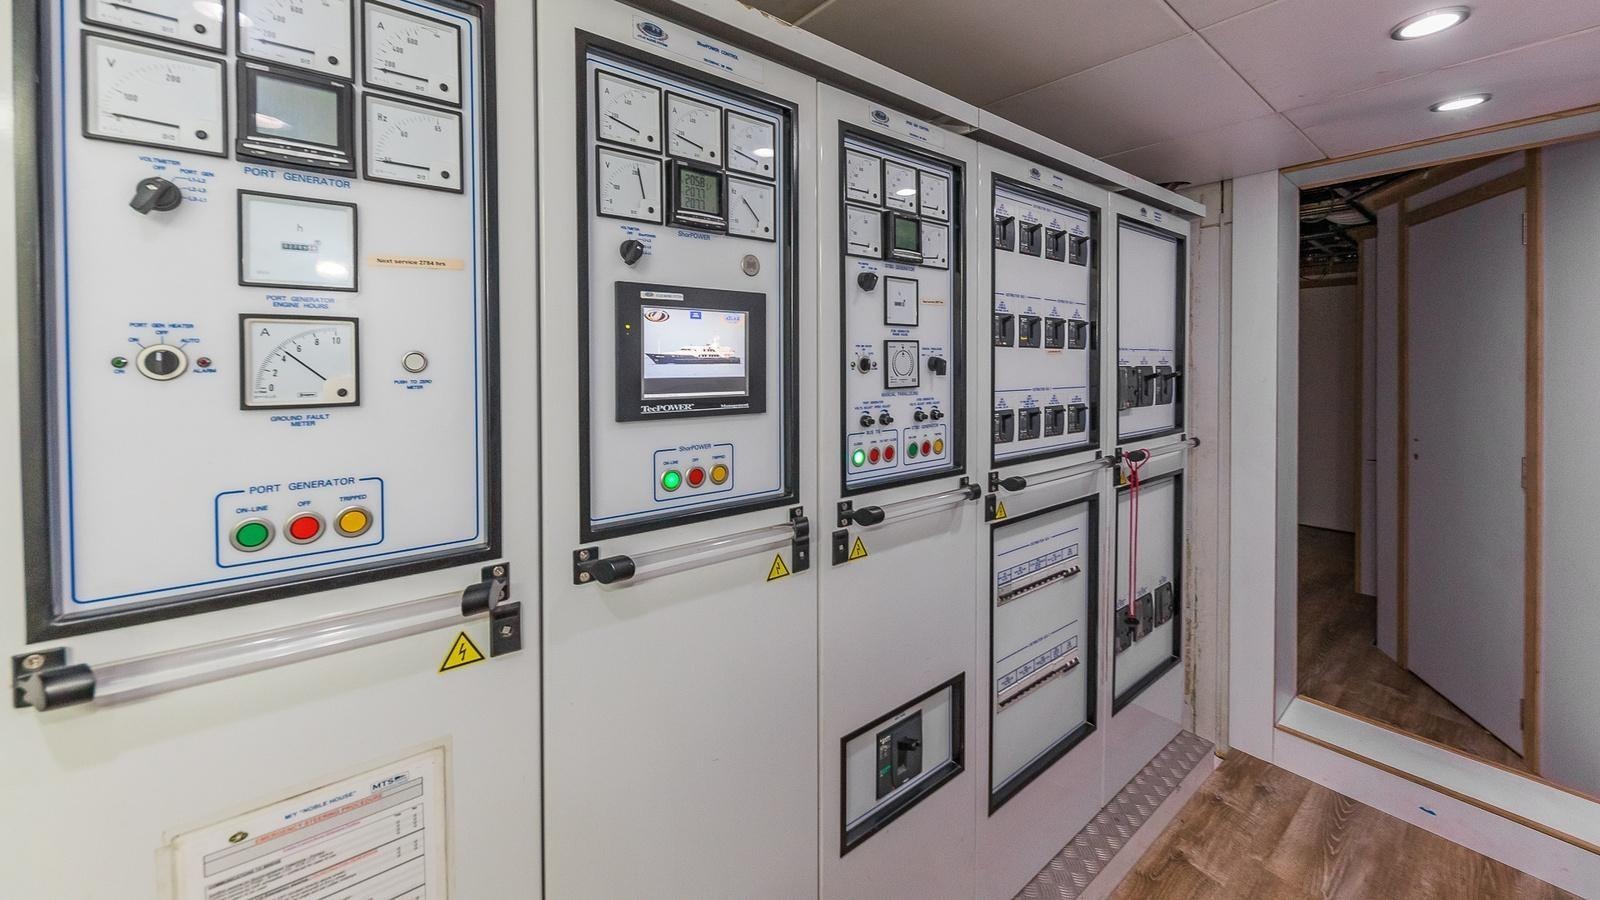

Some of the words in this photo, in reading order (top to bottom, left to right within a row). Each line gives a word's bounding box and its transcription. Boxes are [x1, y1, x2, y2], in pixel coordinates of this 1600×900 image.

[377, 21, 385, 31] A
[106, 57, 117, 67] V
[384, 59, 396, 68] 200
[166, 74, 181, 83] 200
[604, 87, 611, 95] A
[377, 113, 388, 122] Hz
[243, 166, 276, 179] PORT
[283, 171, 352, 189] GENERATOR
[678, 231, 711, 240] ShorPOWER
[394, 258, 418, 266] service
[291, 296, 336, 304] GENERATOR
[260, 328, 270, 337] A
[314, 338, 320, 346] 8
[332, 337, 341, 345] 10
[296, 345, 302, 353] 6
[281, 354, 287, 362] 4
[273, 369, 279, 377] 2
[269, 384, 274, 392] 0
[641, 404, 693, 414] TecPOWER
[270, 415, 302, 423] GROUND
[306, 413, 331, 421] FAULT
[679, 443, 712, 452] ShorPOWER
[249, 484, 281, 494] PORT
[288, 476, 356, 491] GENERATOR
[339, 494, 367, 502] TRIPPED
[236, 505, 269, 514] ON-LINE
[371, 776, 394, 791] MTS
